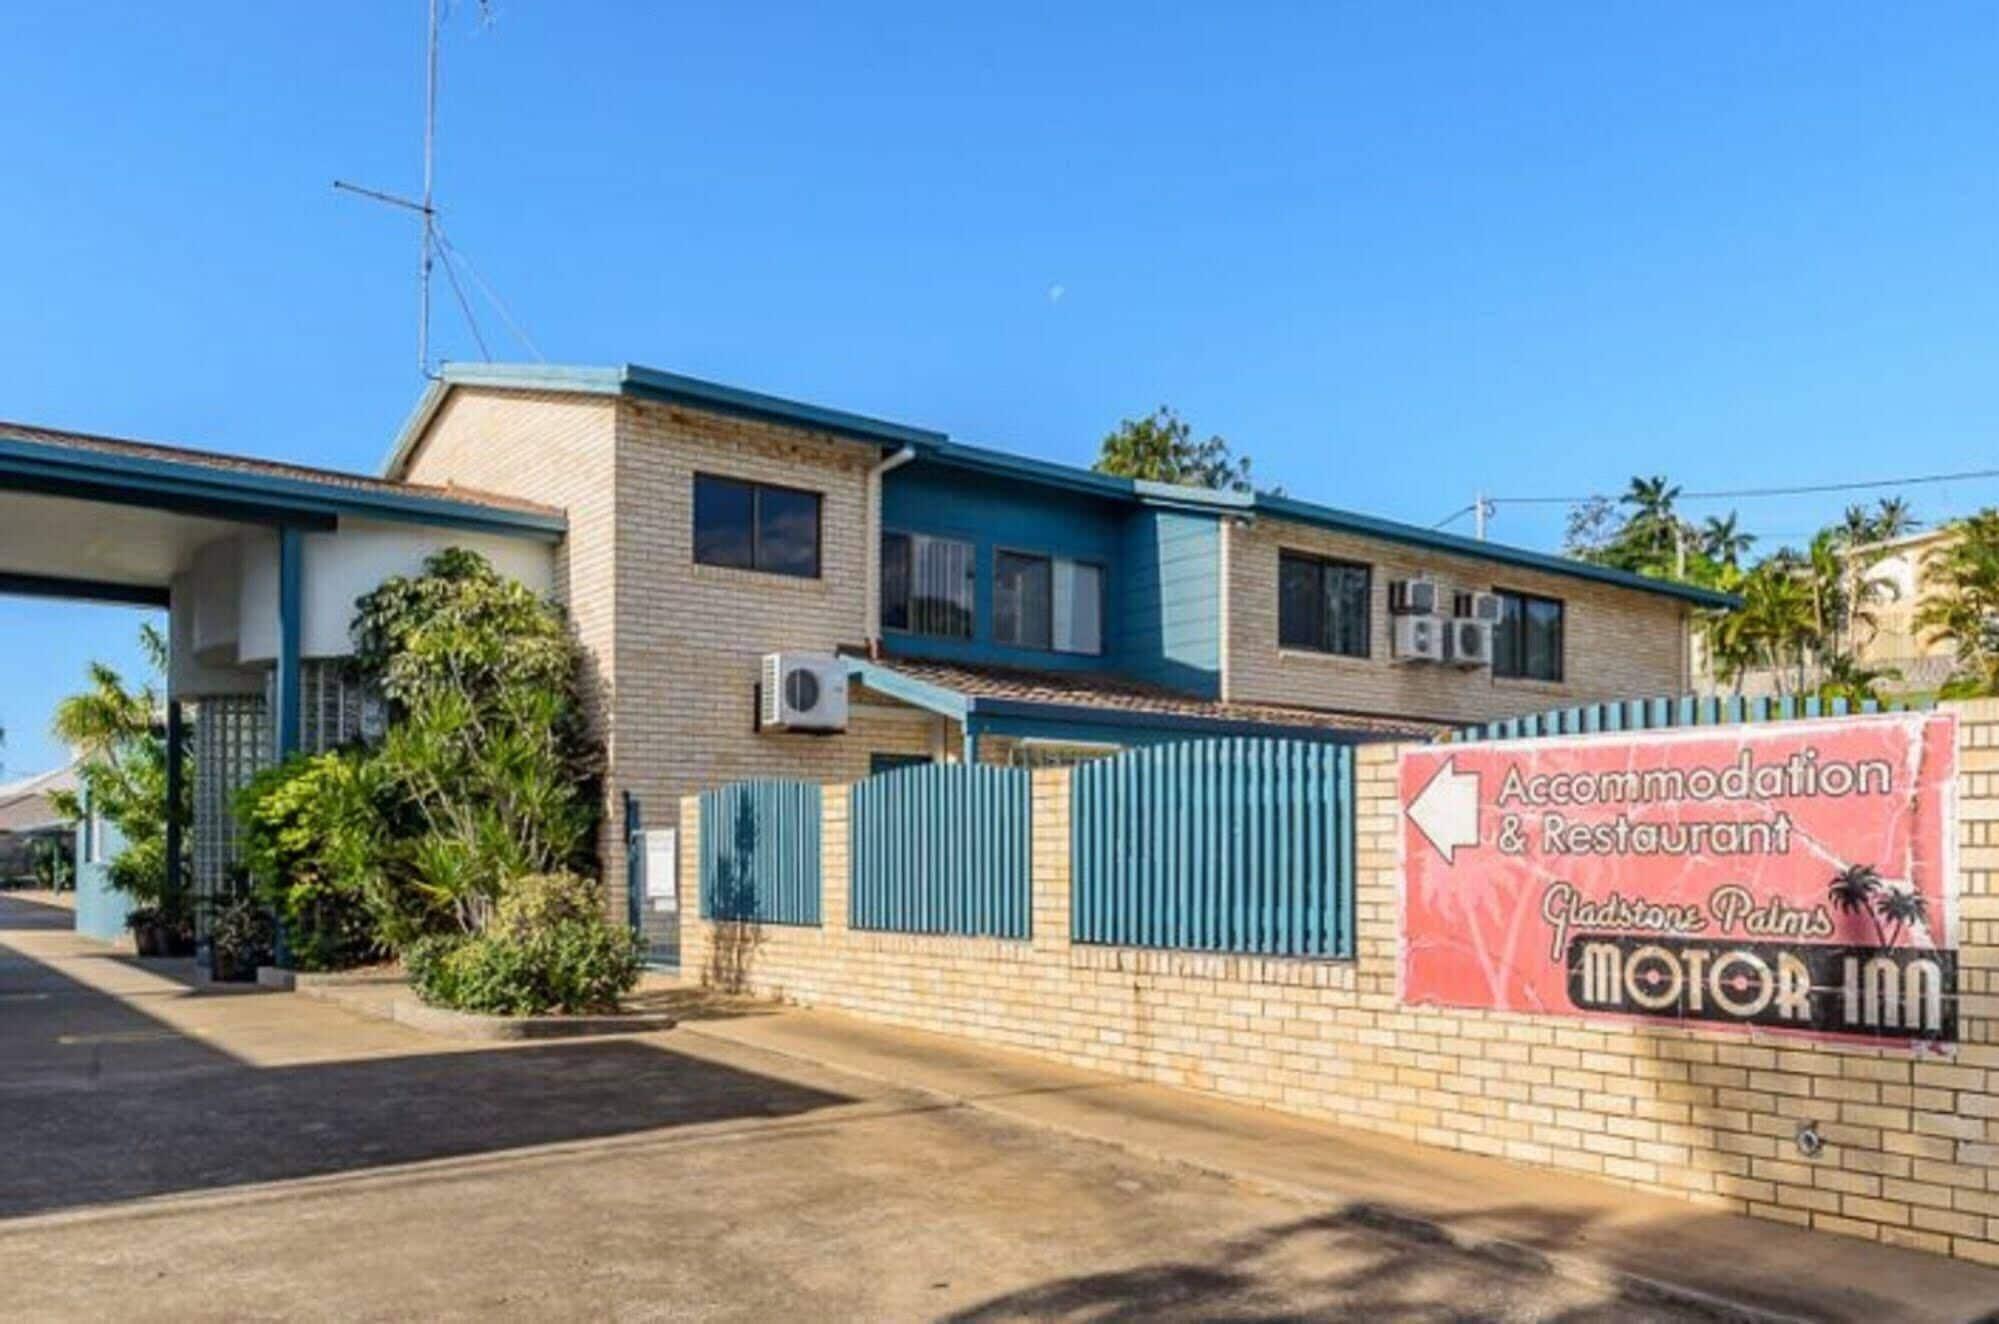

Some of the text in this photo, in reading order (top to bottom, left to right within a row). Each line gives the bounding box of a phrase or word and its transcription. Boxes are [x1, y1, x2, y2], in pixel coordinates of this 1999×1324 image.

[1499, 748, 1892, 806] Accommodation
[1499, 810, 1792, 855] & Restaurant
[1541, 880, 1835, 961] Gladstone Palms
[1582, 941, 1942, 1030] MOTOR INN
